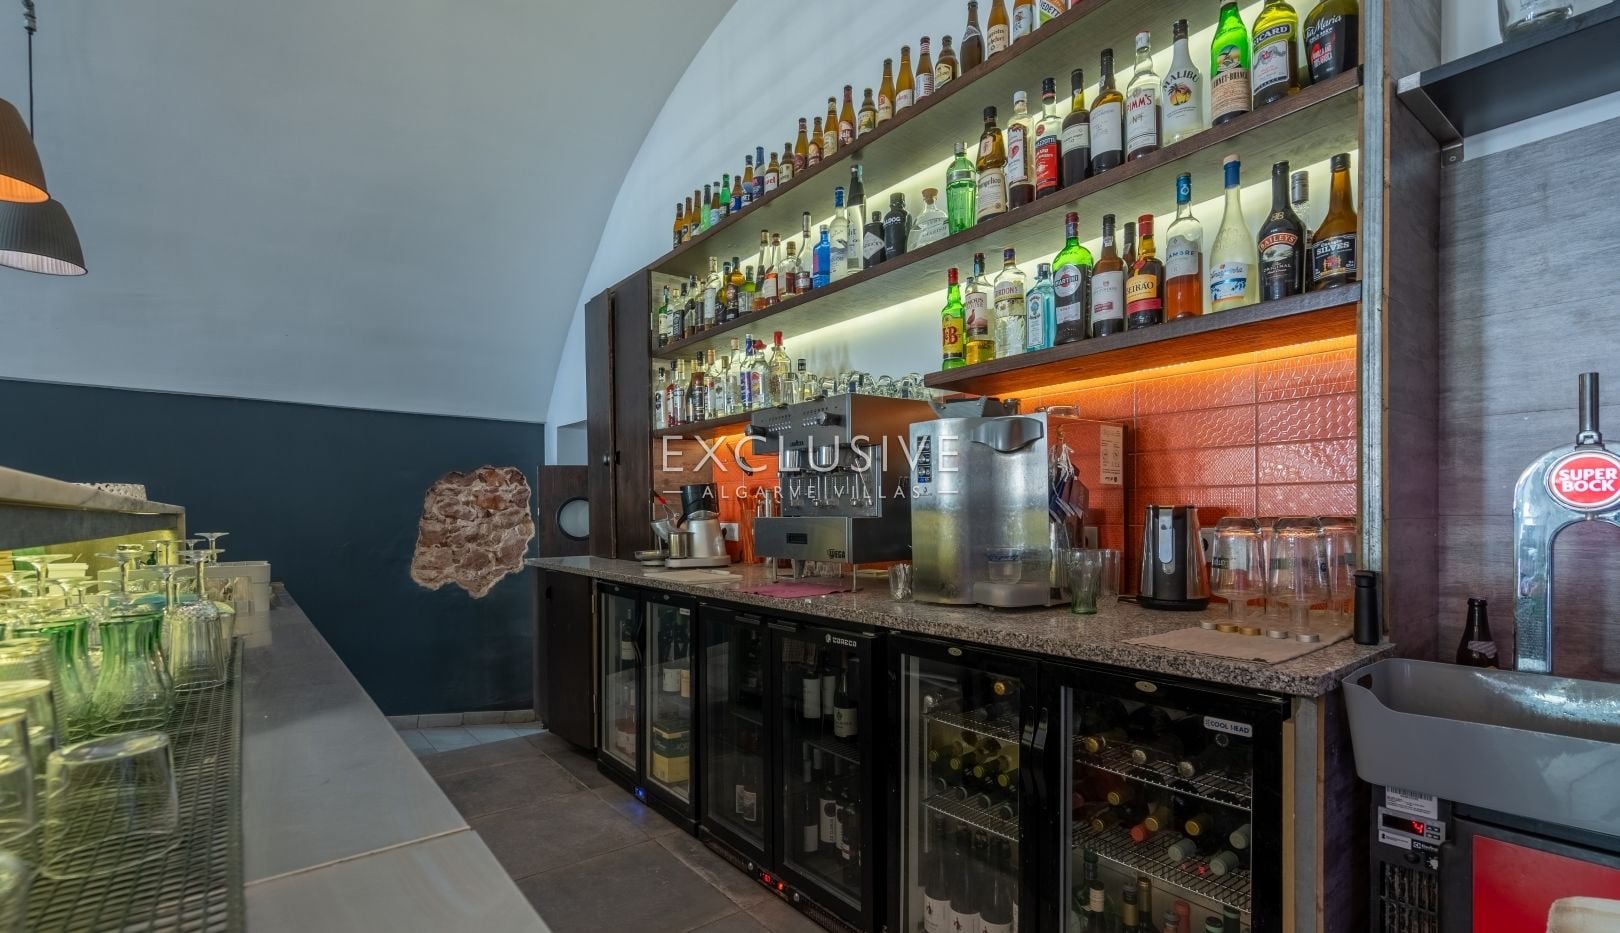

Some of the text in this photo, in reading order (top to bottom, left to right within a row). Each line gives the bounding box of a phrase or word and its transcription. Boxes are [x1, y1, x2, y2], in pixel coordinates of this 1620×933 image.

[1314, 14, 1342, 34] Maria
[1163, 69, 1200, 89] MALIBU
[1260, 235, 1296, 249] BAILEYS
[1316, 241, 1350, 256] SILVES
[1559, 467, 1618, 481] SUPER
[1561, 480, 1615, 493] BOCK
[1210, 720, 1250, 734] COOL HEAD
